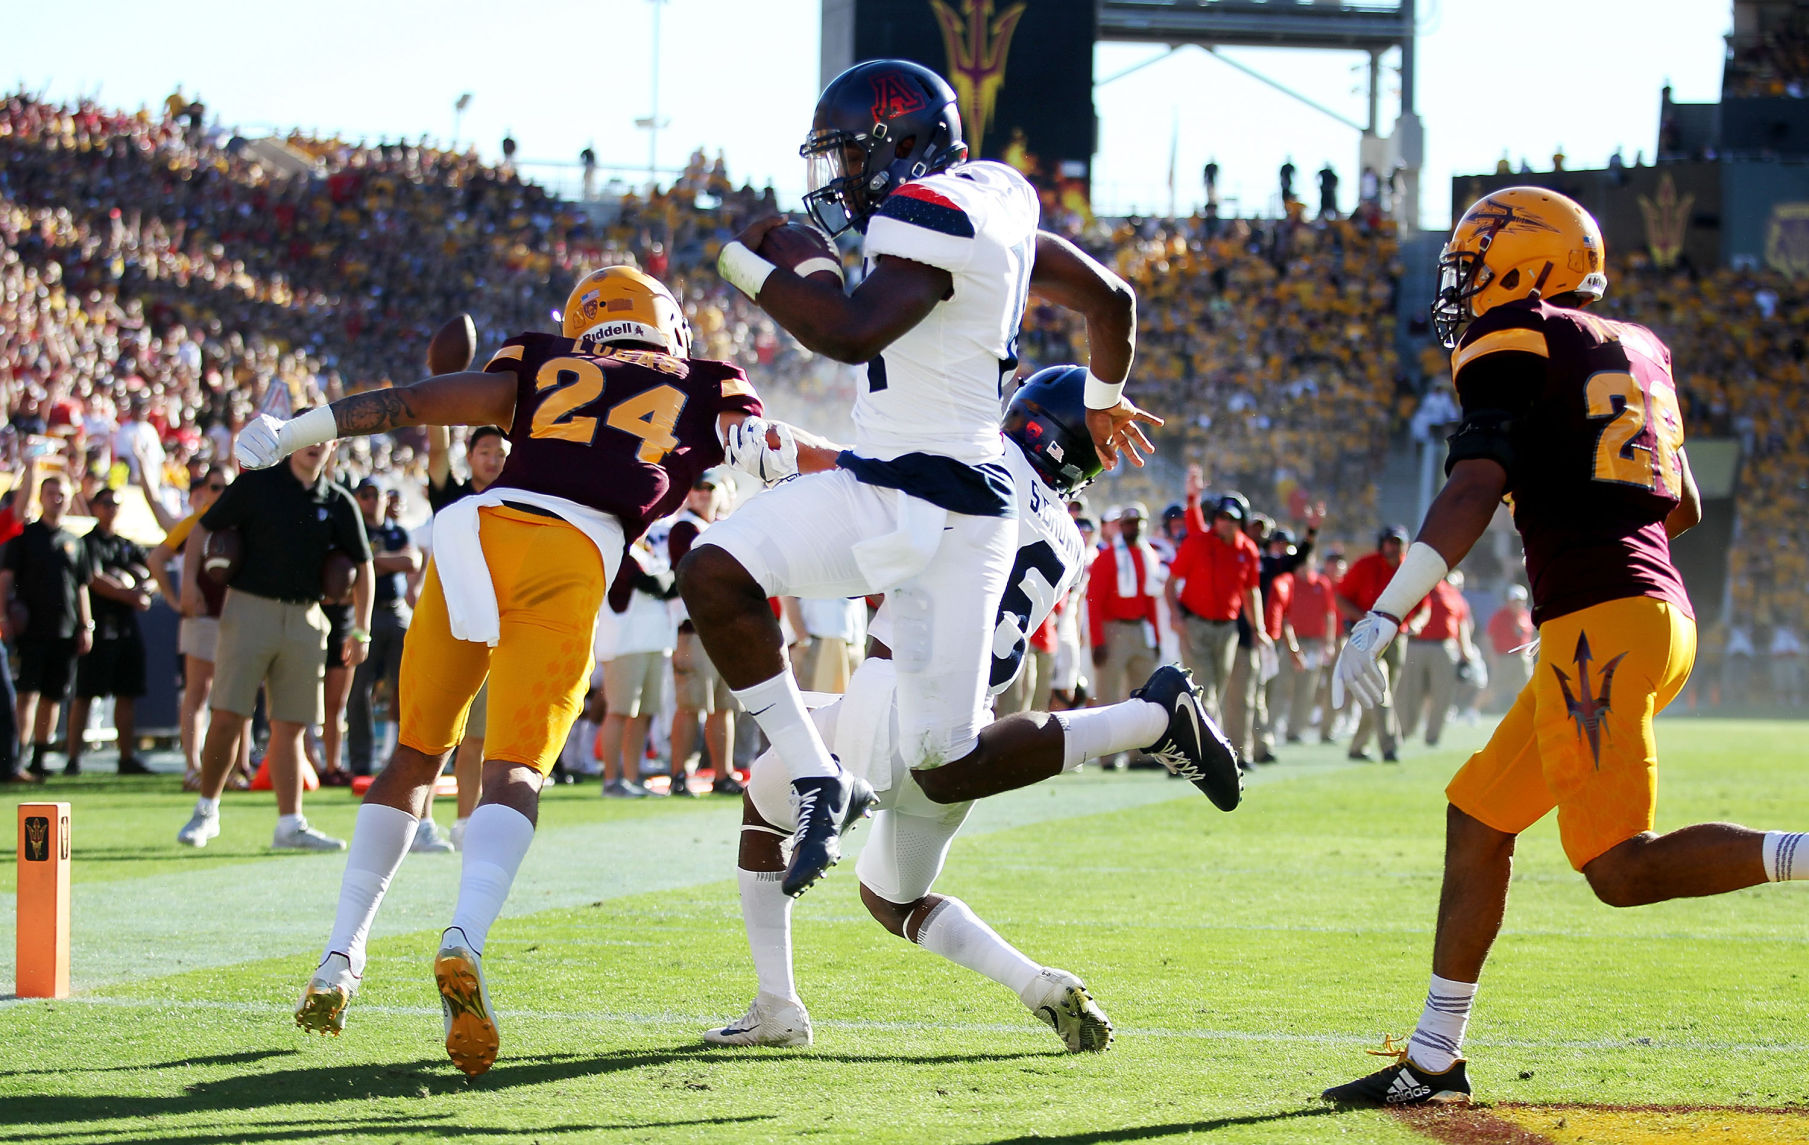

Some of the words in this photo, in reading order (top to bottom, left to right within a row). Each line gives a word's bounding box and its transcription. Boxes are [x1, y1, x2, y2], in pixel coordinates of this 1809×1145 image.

[868, 70, 926, 123] A
[583, 323, 632, 342] Riddell
[529, 356, 689, 466] 24
[1386, 1085, 1431, 1103] adidas
